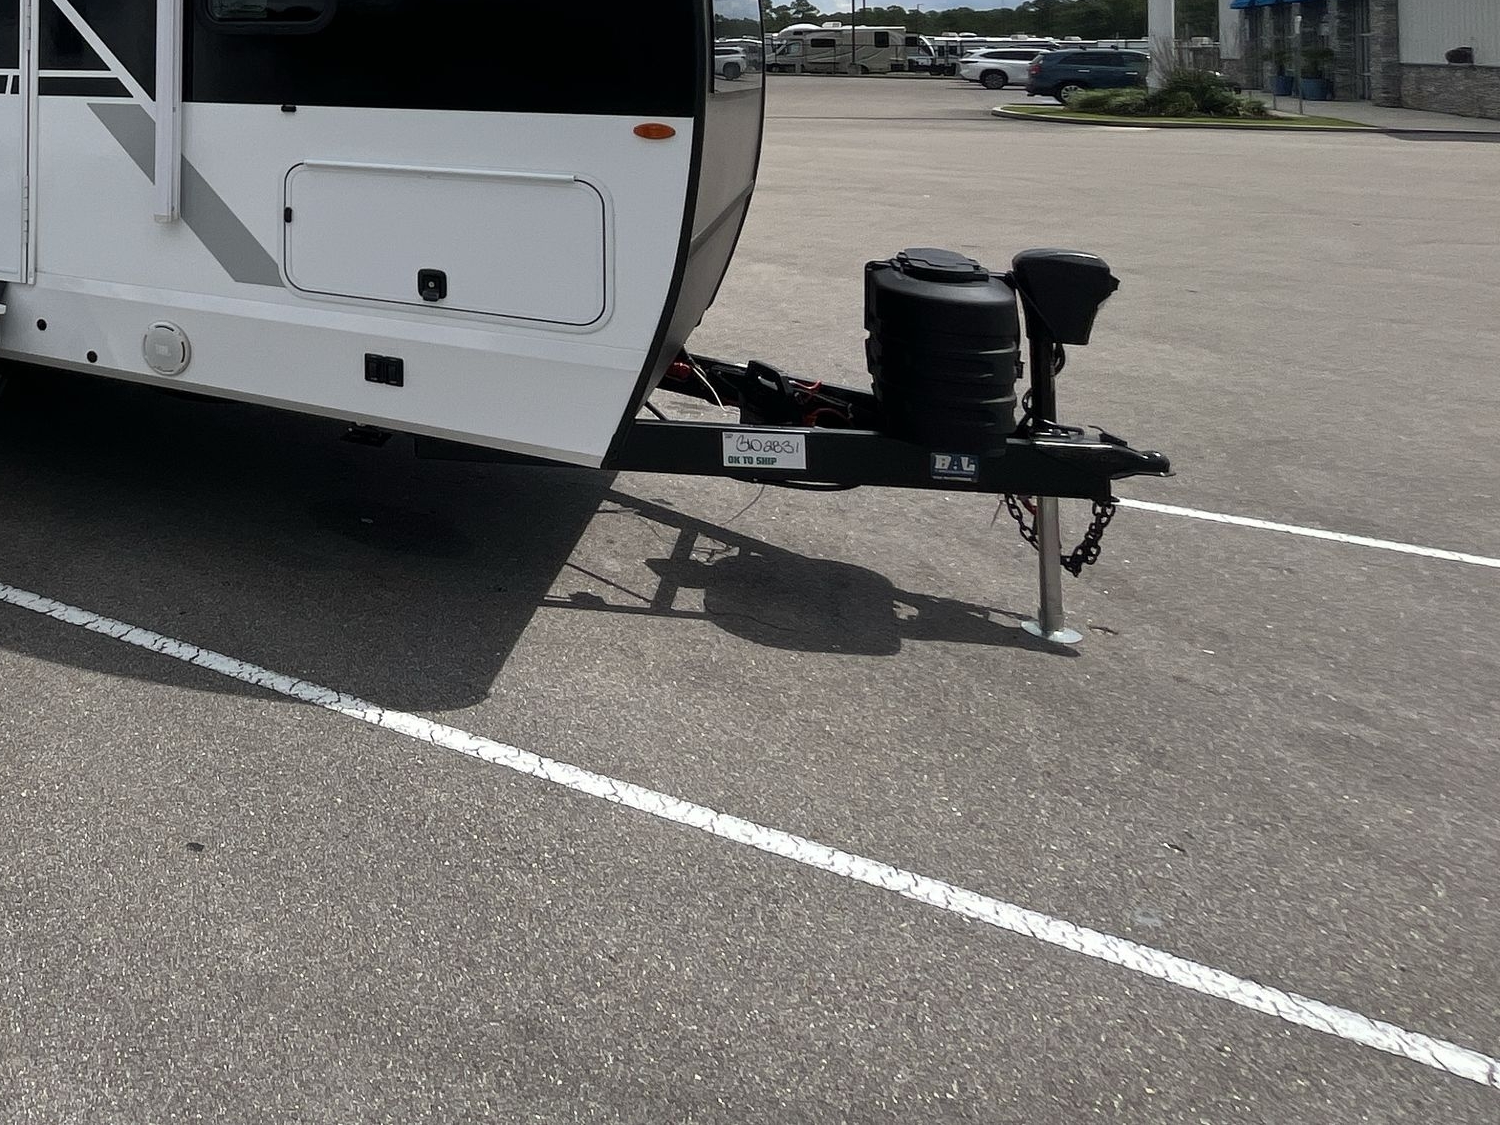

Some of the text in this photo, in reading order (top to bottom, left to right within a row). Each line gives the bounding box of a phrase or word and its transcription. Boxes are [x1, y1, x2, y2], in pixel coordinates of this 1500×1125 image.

[727, 456, 777, 465] OK TO SHIP
